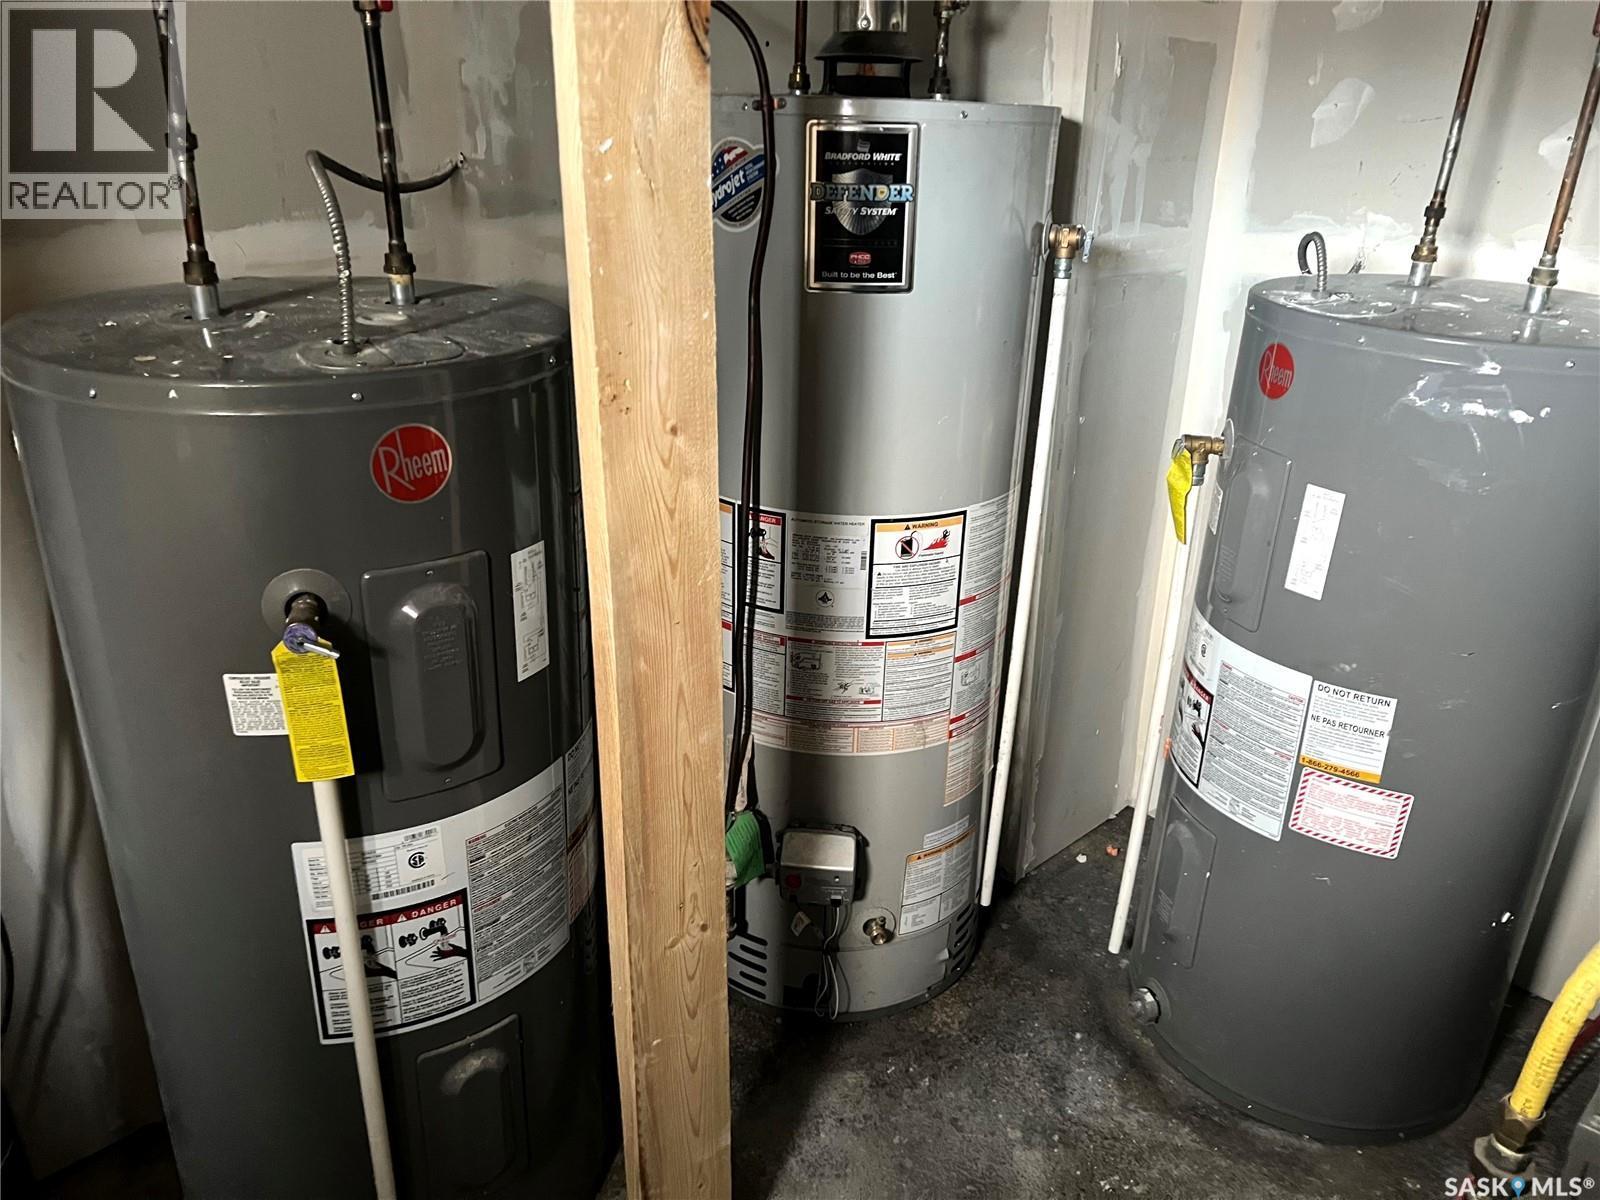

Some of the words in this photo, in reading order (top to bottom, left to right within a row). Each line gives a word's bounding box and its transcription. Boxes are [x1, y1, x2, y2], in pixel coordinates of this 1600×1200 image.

[824, 151, 871, 161] BRADFORD
[872, 152, 902, 161] WHITE
[711, 169, 745, 208] ydrojet
[810, 182, 914, 202] DEFENDER
[860, 207, 898, 216] SYSTEM
[862, 271, 875, 279] the
[1260, 345, 1293, 391] Rheem
[378, 430, 448, 494] Rheem
[912, 521, 939, 529] WARNING
[1317, 684, 1331, 694] DO
[1332, 688, 1352, 699] NOT
[1353, 693, 1391, 707] RETURN
[1310, 713, 1321, 723] NE
[1322, 717, 1337, 727] PAS
[1338, 721, 1385, 738] RETOURNER
[411, 899, 457, 918] DANGER
[359, 918, 384, 928] GER
